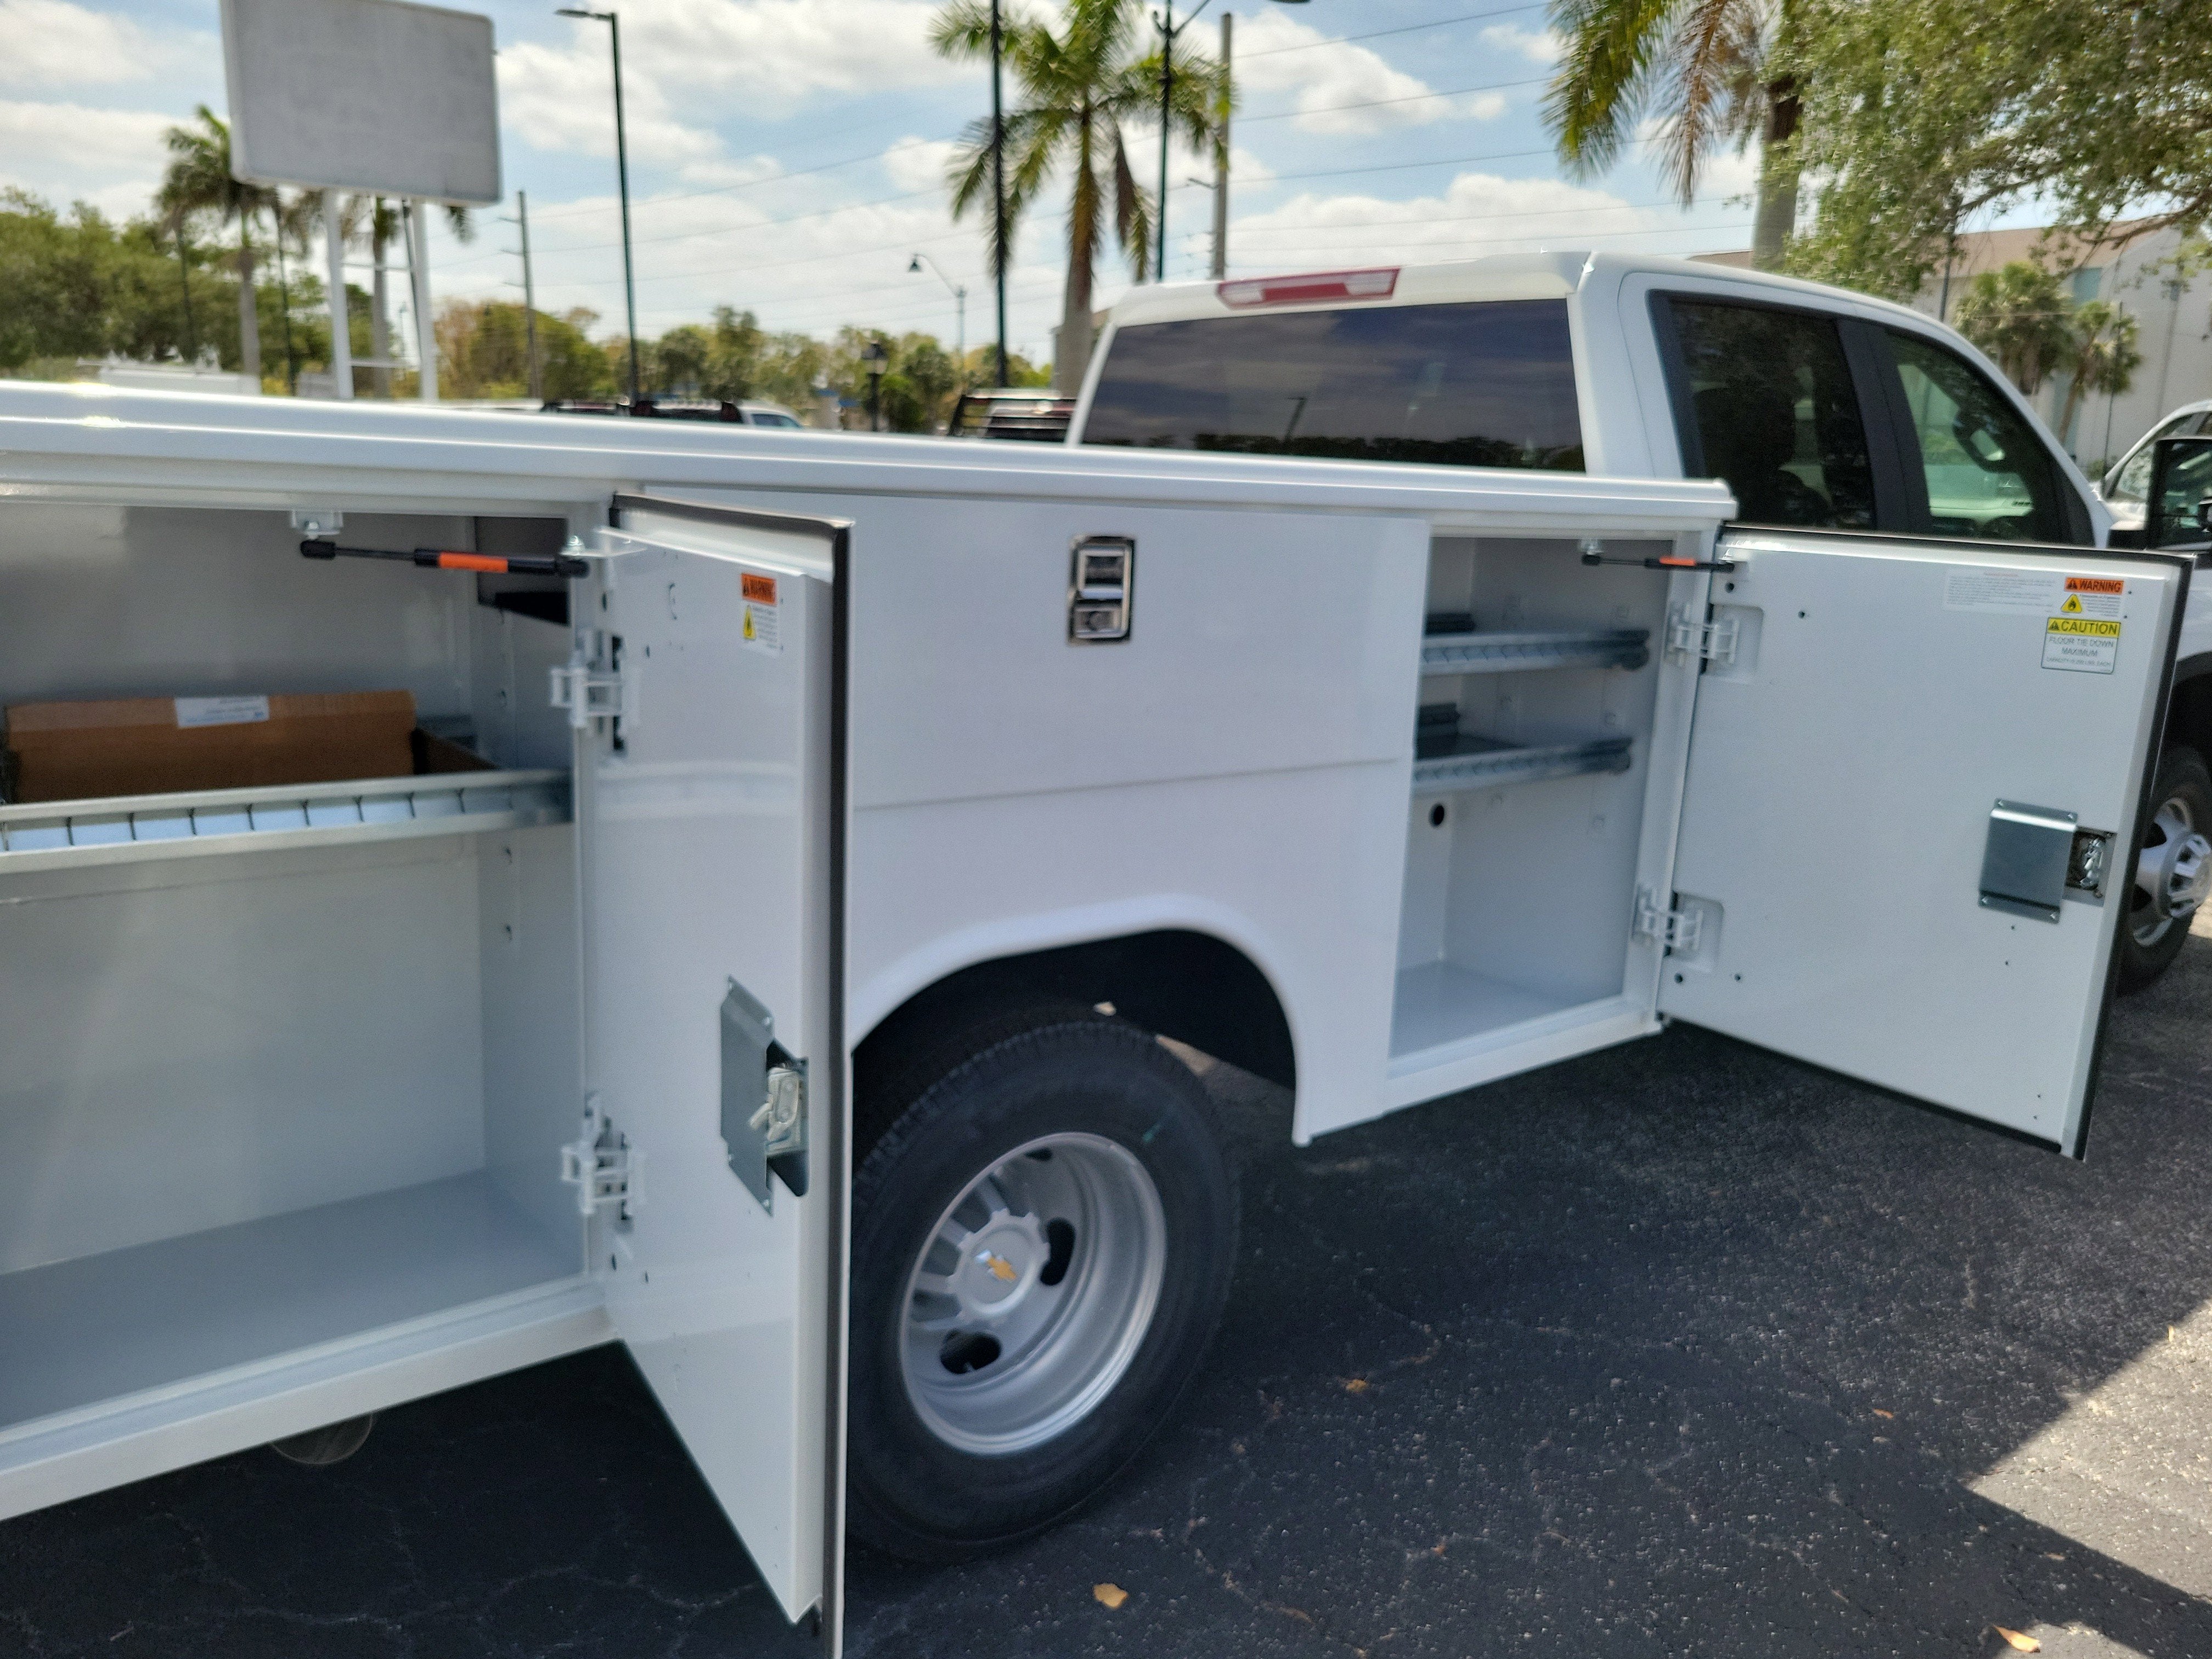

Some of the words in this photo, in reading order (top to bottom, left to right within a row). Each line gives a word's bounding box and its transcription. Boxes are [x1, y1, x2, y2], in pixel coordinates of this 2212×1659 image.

[2079, 579, 2121, 592] WARNING
[2061, 620, 2117, 634] CAUTION
[2049, 636, 2074, 645] FLOOR
[2061, 647, 2097, 657] MAXIMUM
